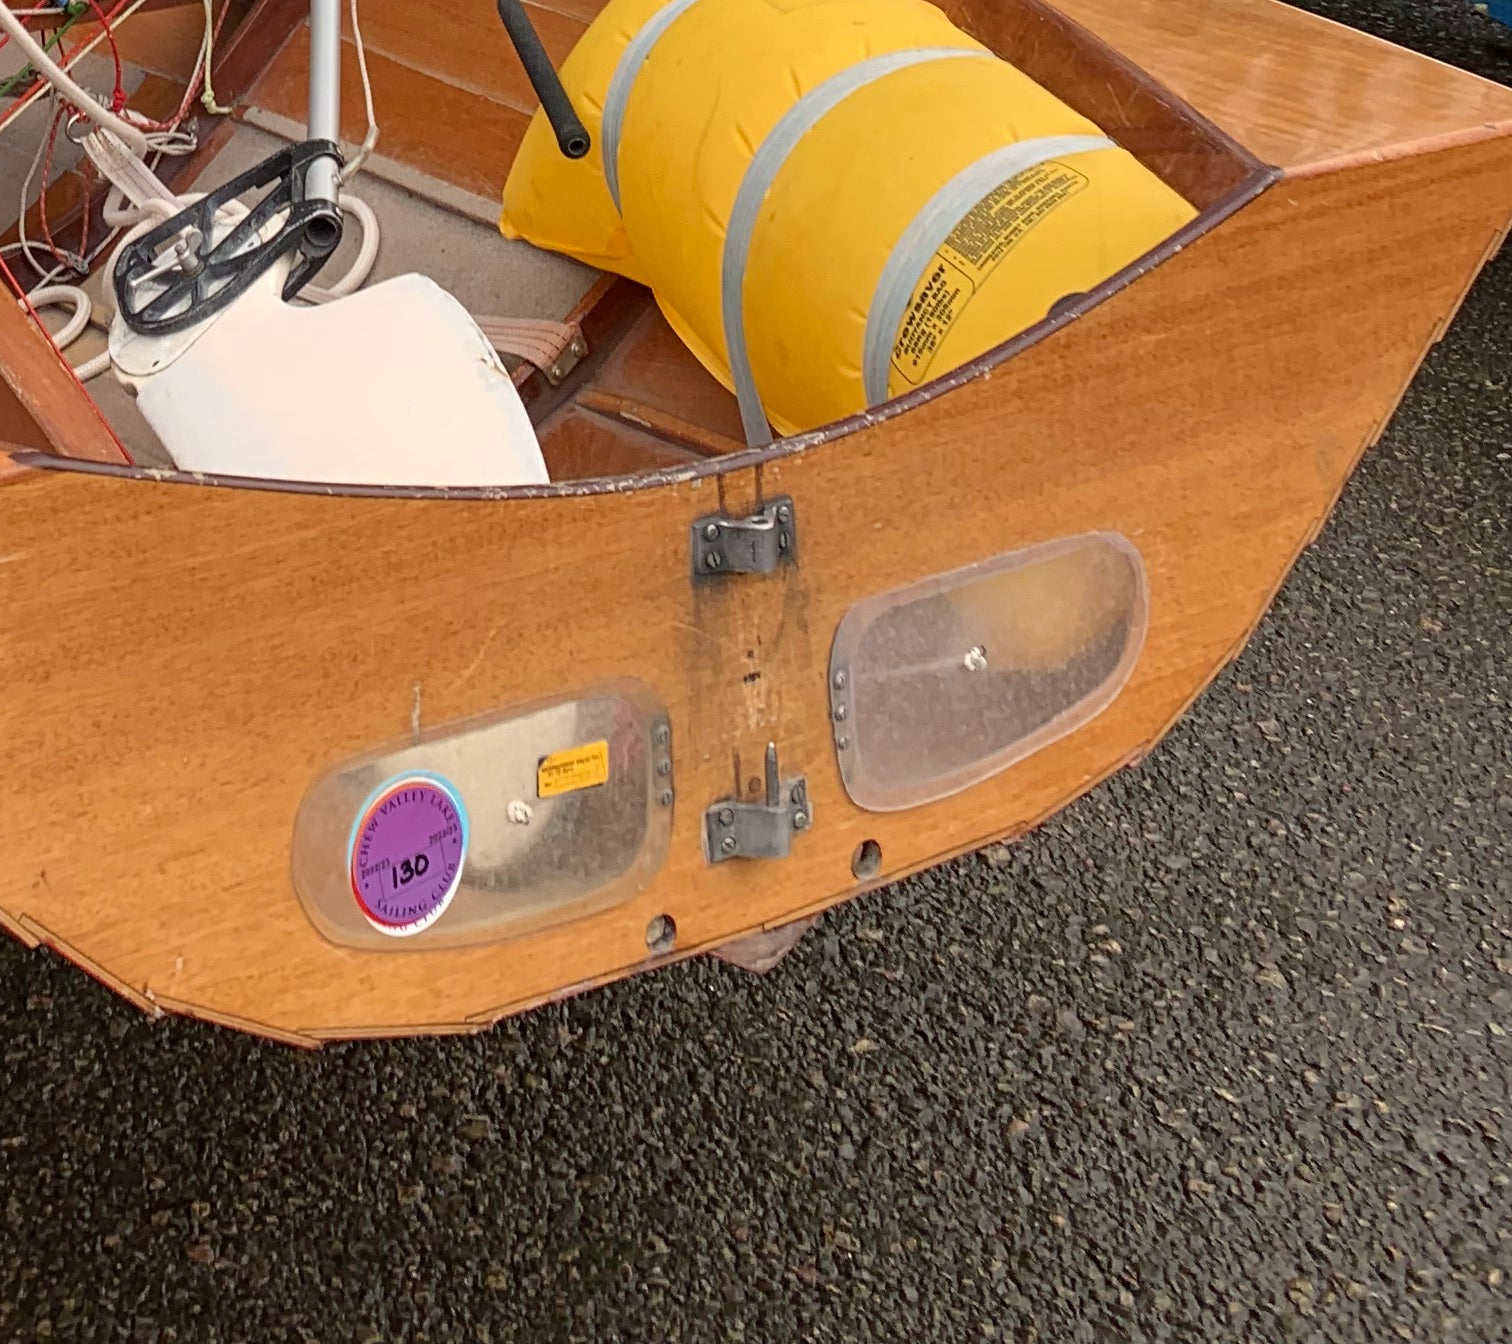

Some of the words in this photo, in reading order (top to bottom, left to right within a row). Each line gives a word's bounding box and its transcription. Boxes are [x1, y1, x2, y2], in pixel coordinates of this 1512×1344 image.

[359, 816, 378, 867] CHEW
[380, 790, 425, 815] VALLEY
[430, 794, 455, 821] LAKE
[376, 898, 428, 918] SAILING
[431, 863, 456, 901] CLUB
[392, 854, 430, 890] 130
